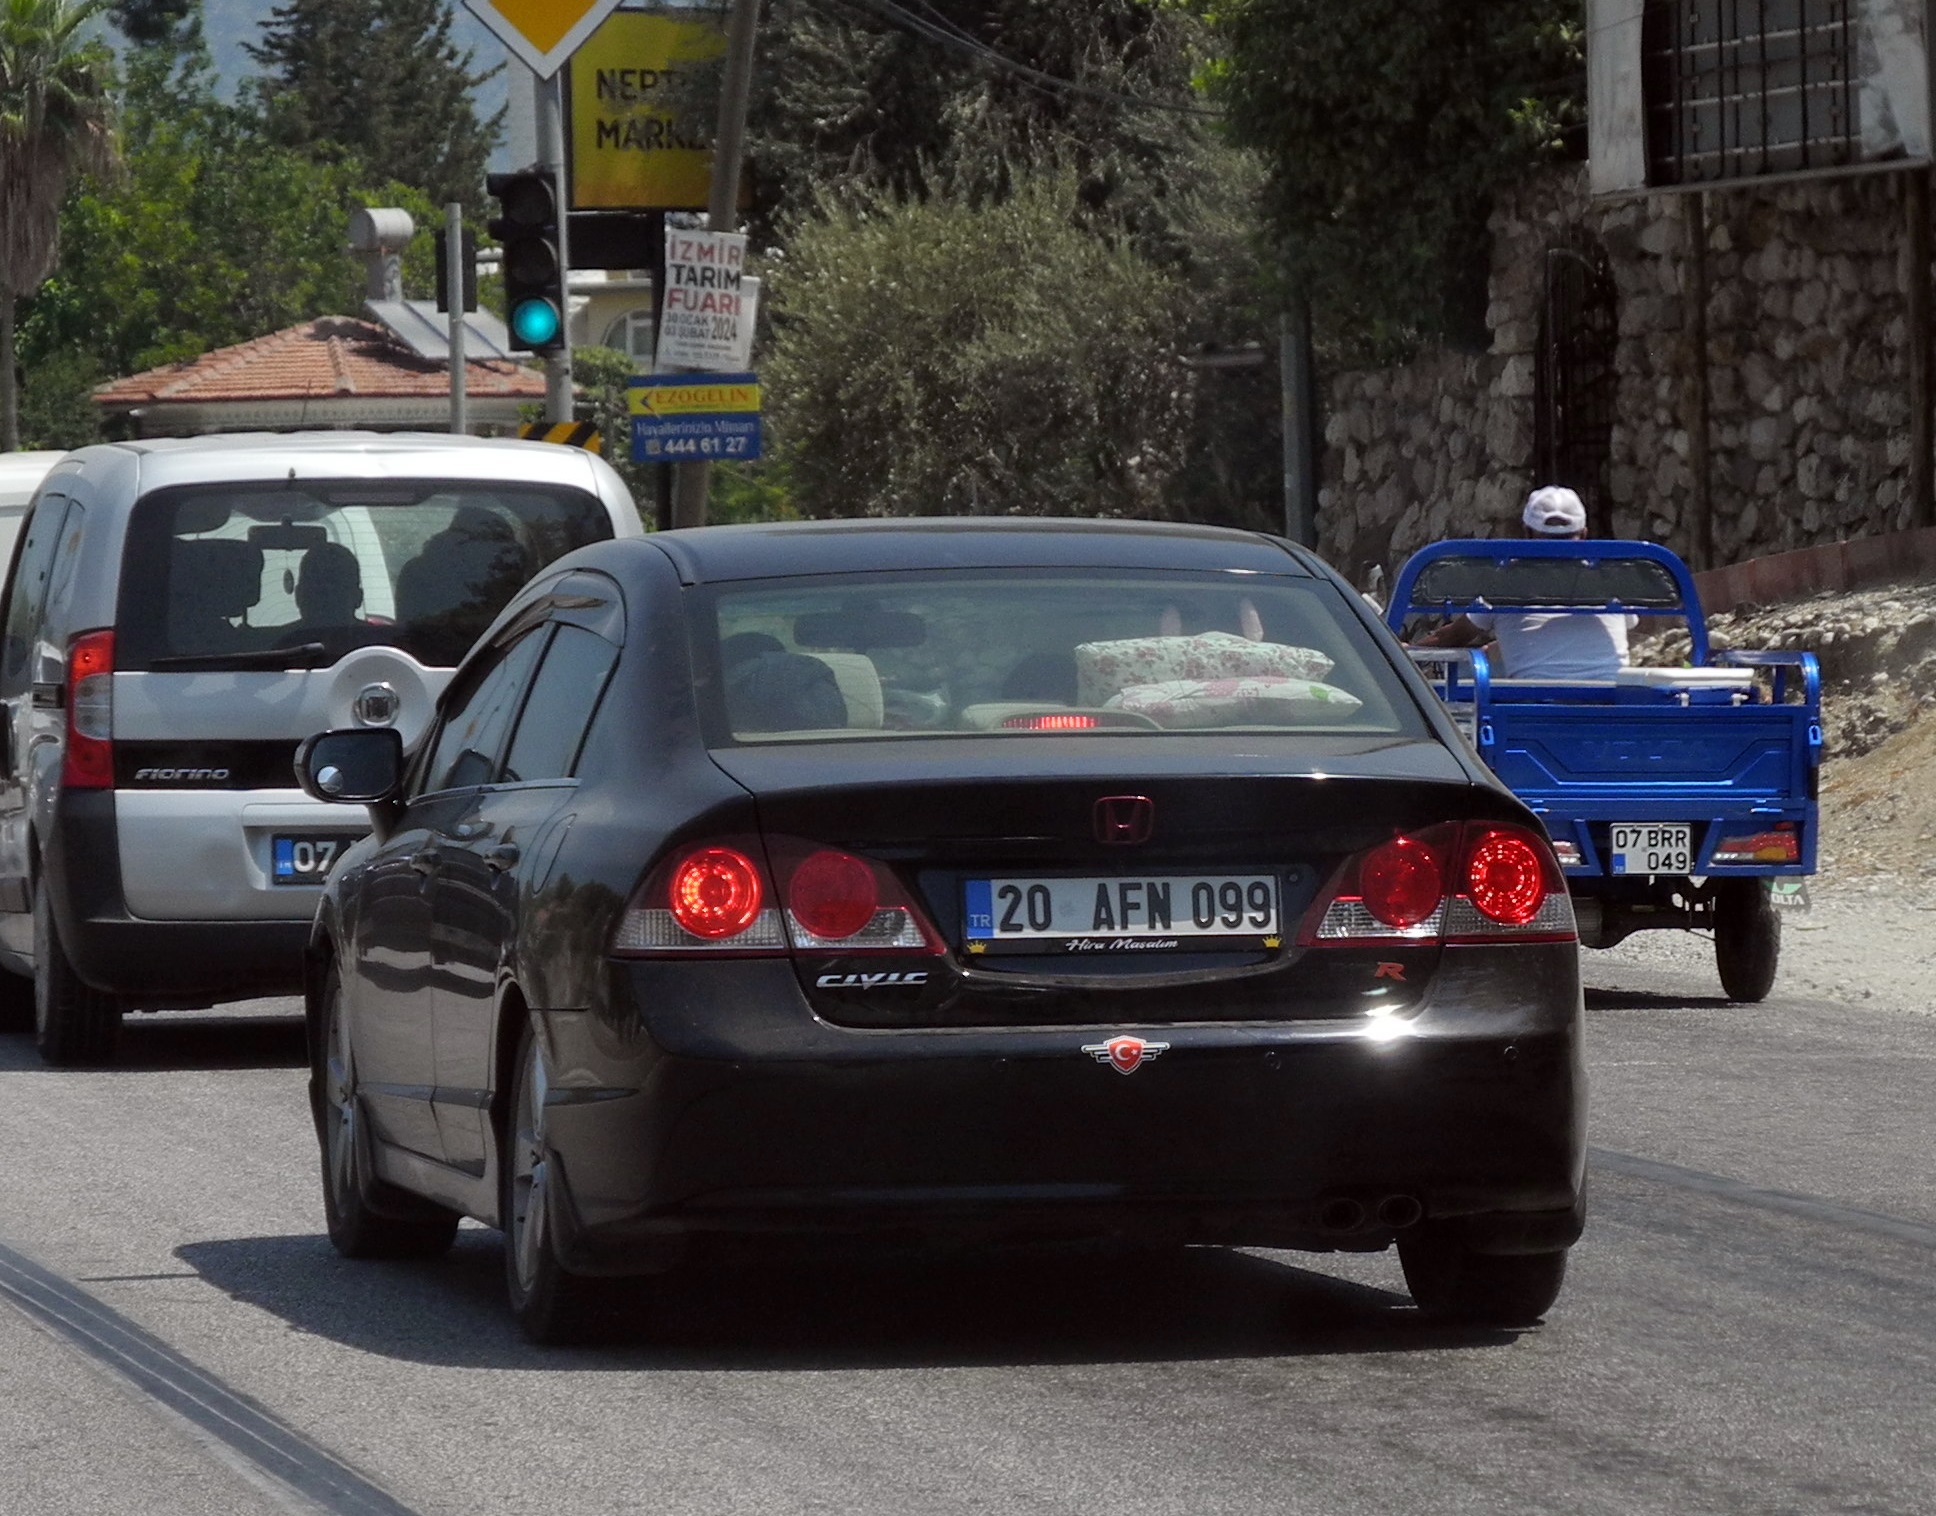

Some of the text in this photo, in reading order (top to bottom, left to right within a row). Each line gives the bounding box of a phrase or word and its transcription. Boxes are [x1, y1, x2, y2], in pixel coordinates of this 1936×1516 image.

[669, 234, 742, 266] İZMİR
[671, 264, 741, 291] TARIM
[667, 288, 742, 316] FUARI
[679, 313, 708, 326] OCAK
[711, 315, 738, 341] 2024
[665, 436, 748, 454] 444 61 27
[1616, 829, 1688, 848] 07 BRR
[293, 841, 338, 873] 07
[1647, 851, 1688, 871] 049
[970, 881, 1272, 933] TR 20 AFN 099
[1065, 938, 1106, 951] Hira
[816, 971, 929, 989] CIVIC
[1374, 962, 1408, 982] R
